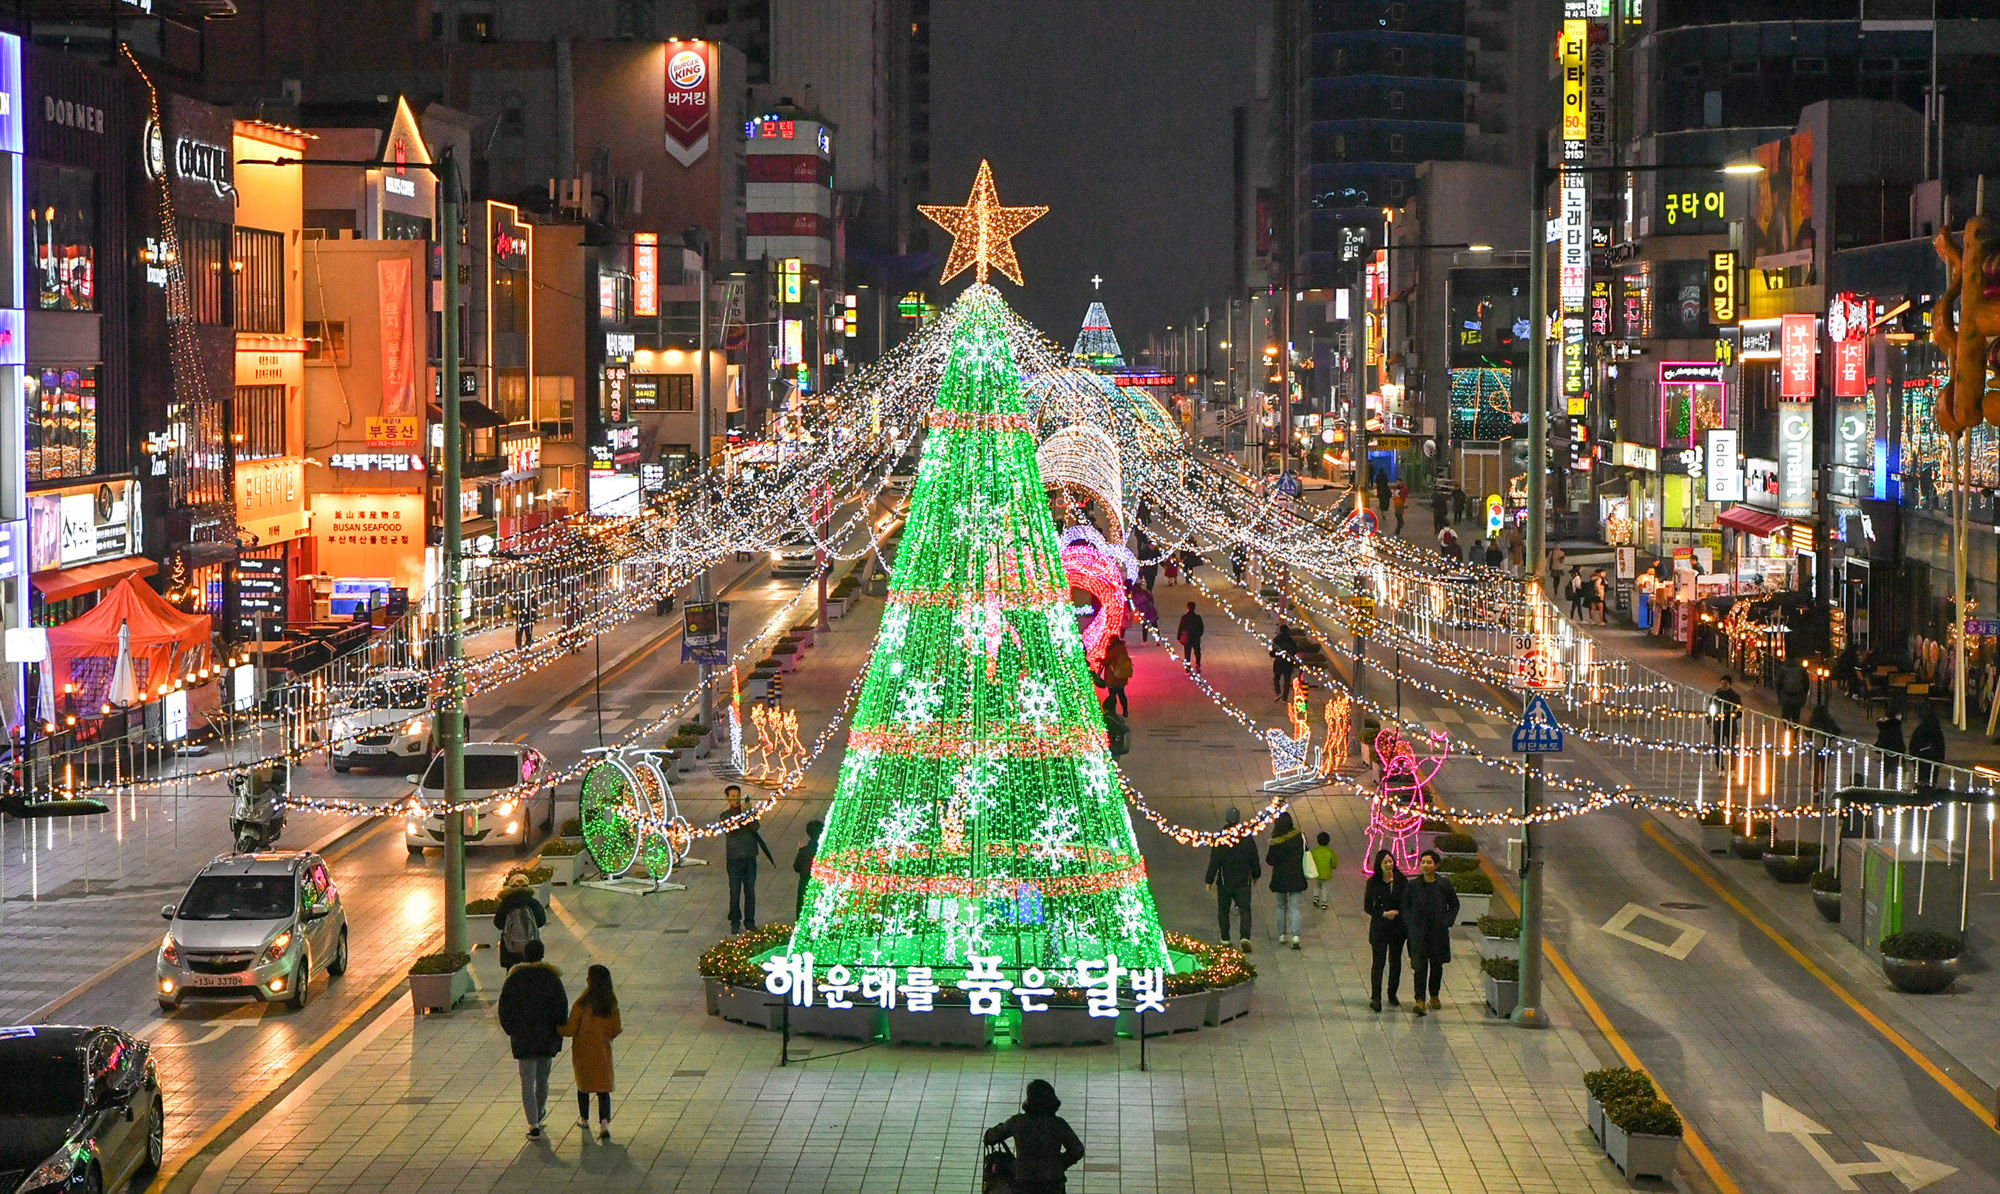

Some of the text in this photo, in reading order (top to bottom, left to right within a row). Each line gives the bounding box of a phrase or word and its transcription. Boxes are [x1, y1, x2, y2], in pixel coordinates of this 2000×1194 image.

[673, 58, 700, 72] BURGER
[674, 65, 701, 80] KING
[1566, 39, 1585, 112] 더타이
[668, 91, 706, 106] 버거킹
[762, 120, 794, 139] 모텔
[1564, 150, 1584, 159] 3153
[1565, 177, 1584, 187] TEN
[1665, 191, 1725, 225] 궁타이
[1567, 191, 1582, 264] 노래타운
[1714, 252, 1735, 320] 타이킹
[1592, 298, 1607, 335] 마사지
[1565, 343, 1582, 392] 야구존
[369, 425, 414, 438] 부동산
[330, 453, 410, 471] 오복돼지국밥
[1780, 508, 1811, 516] 731-6006
[333, 523, 402, 531] BUSAN SEAFOOD
[1967, 624, 1997, 634] 주차장
[1516, 638, 1532, 650] 30
[1517, 742, 1560, 751] 횡단보도
[217, 977, 238, 986] 3370
[761, 952, 1166, 1018] 해운대를 품은 달빛
